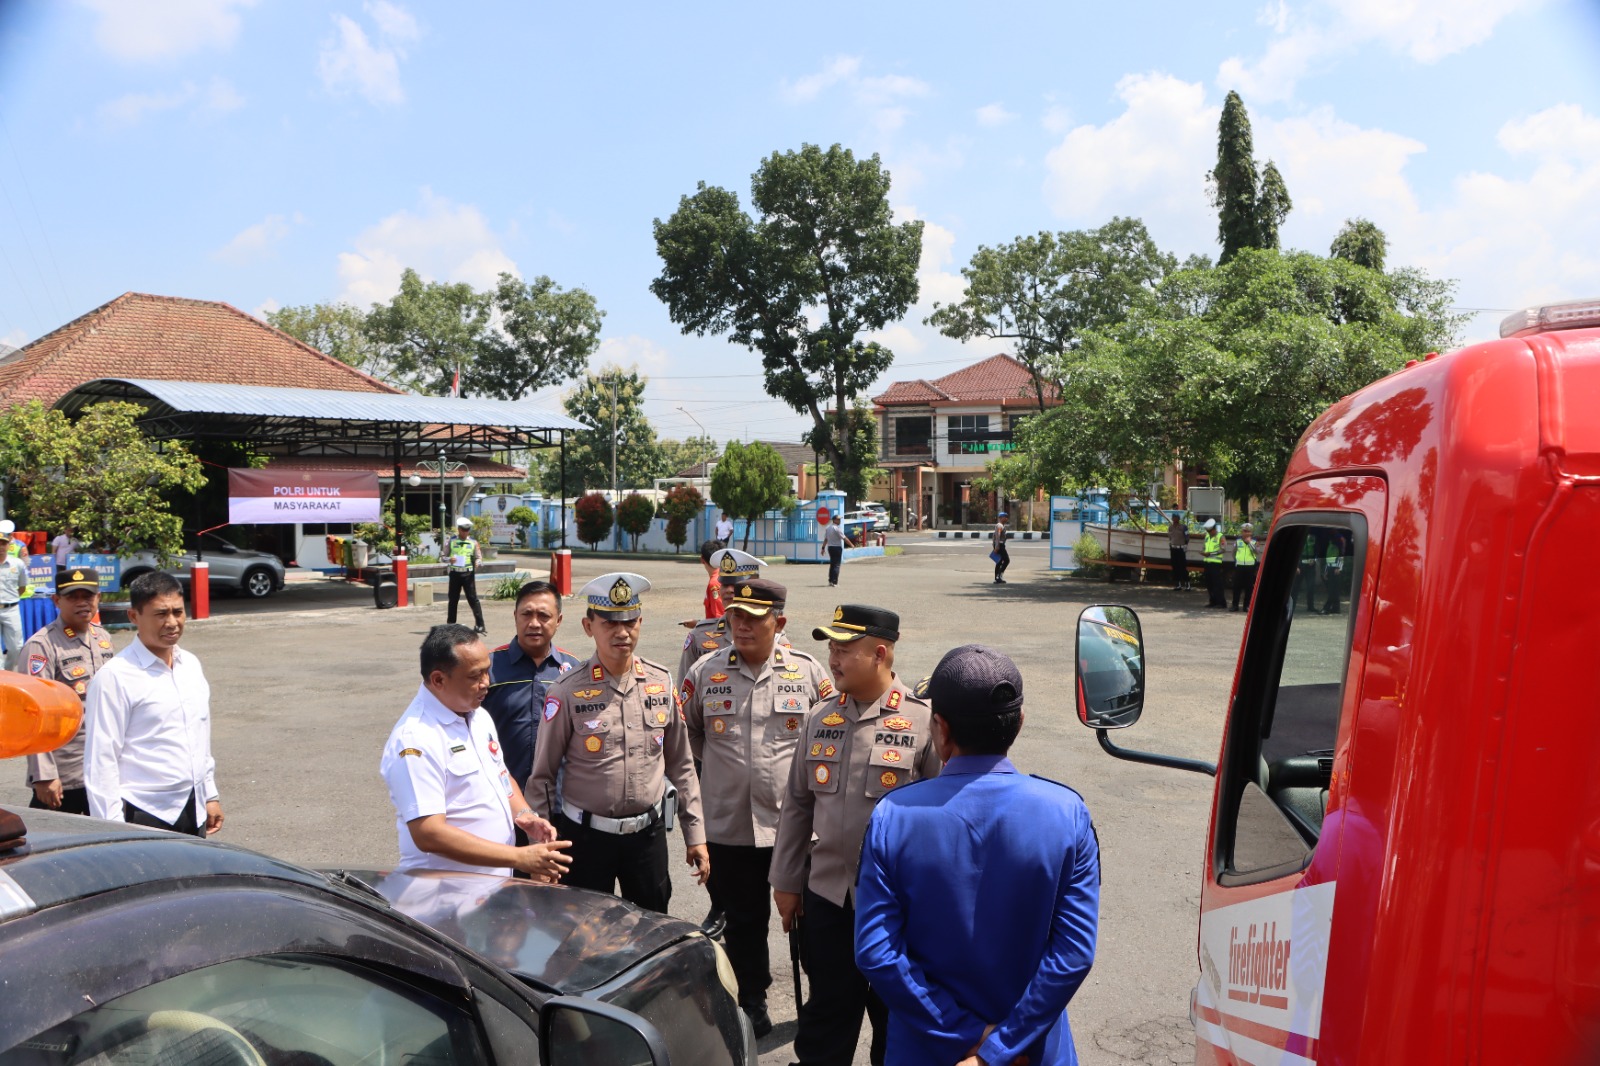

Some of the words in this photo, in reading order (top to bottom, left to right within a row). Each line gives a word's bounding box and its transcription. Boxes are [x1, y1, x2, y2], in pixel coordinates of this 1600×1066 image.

[273, 486, 305, 496] POLRI
[307, 487, 341, 496] UNTUK
[274, 501, 342, 510] MASYARAKAT
[705, 685, 732, 695] AGUS
[777, 685, 805, 694] POLRI
[575, 702, 606, 714] BROTO
[813, 729, 845, 740] JAROT
[875, 732, 915, 747] POLRI
[1228, 921, 1291, 1003] firefighter
